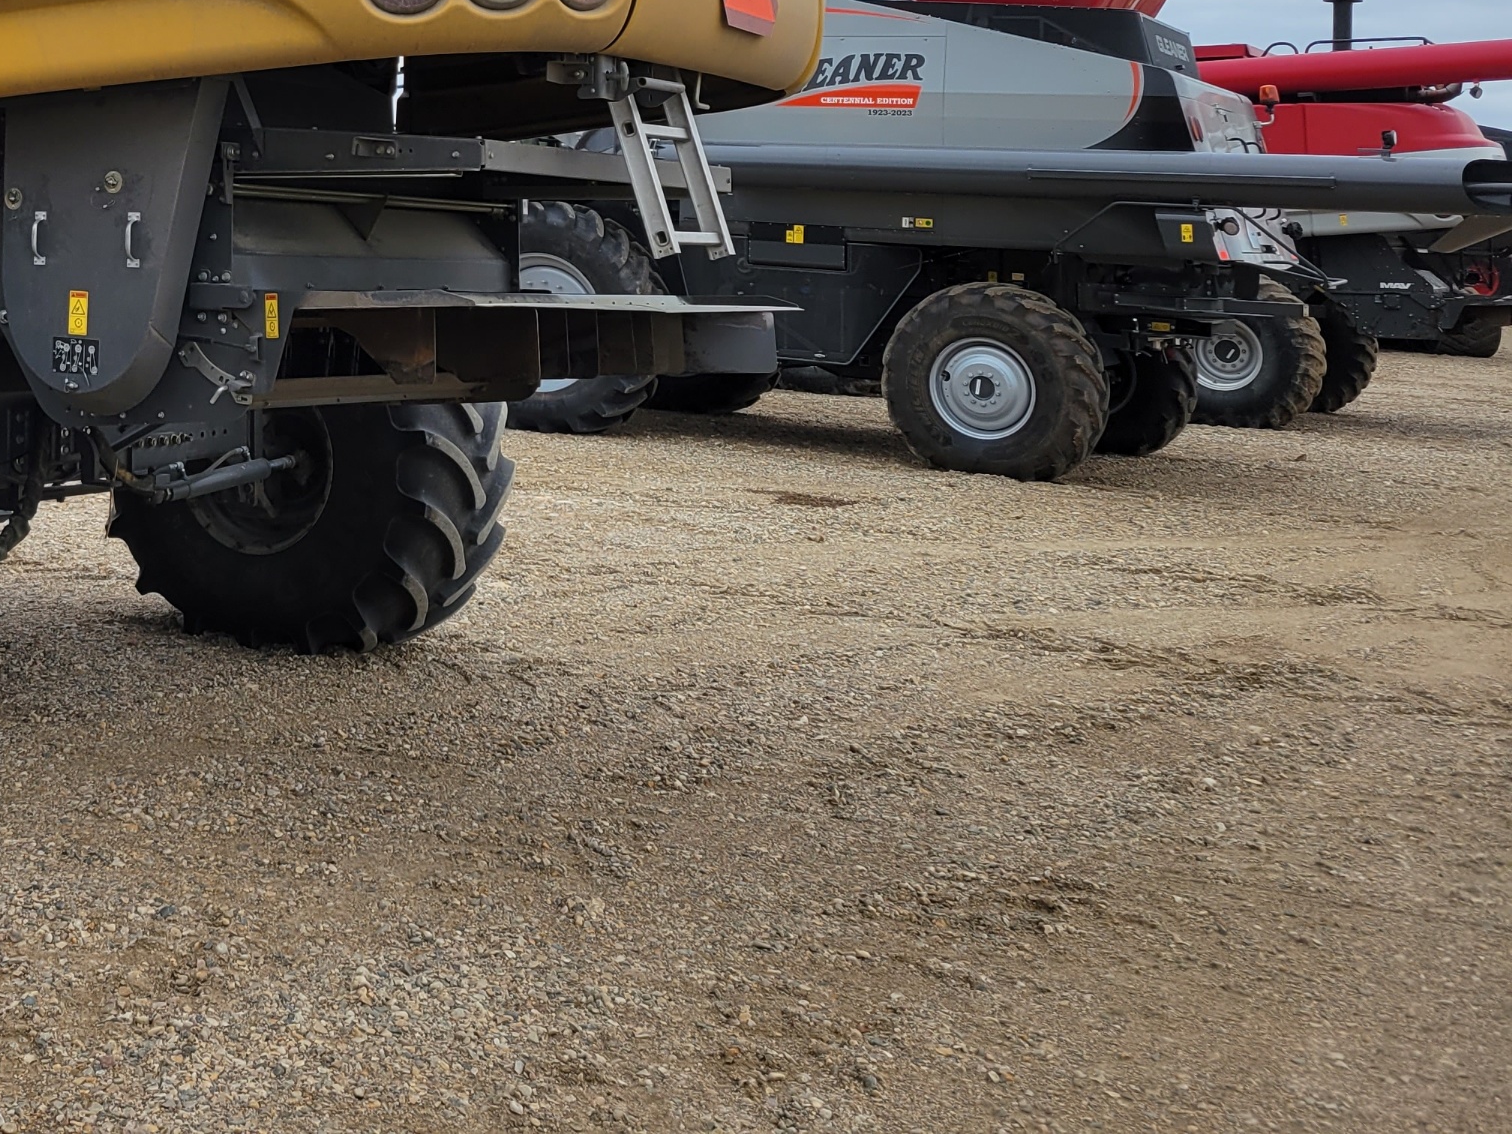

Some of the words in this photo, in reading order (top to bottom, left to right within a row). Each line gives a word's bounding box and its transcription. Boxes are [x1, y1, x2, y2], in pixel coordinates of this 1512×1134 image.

[799, 52, 926, 93] EANER
[820, 96, 875, 105] CENTENNIAL
[876, 97, 914, 105] EDITION
[867, 109, 913, 117] 1923-2023
[1379, 282, 1412, 290] MAV
